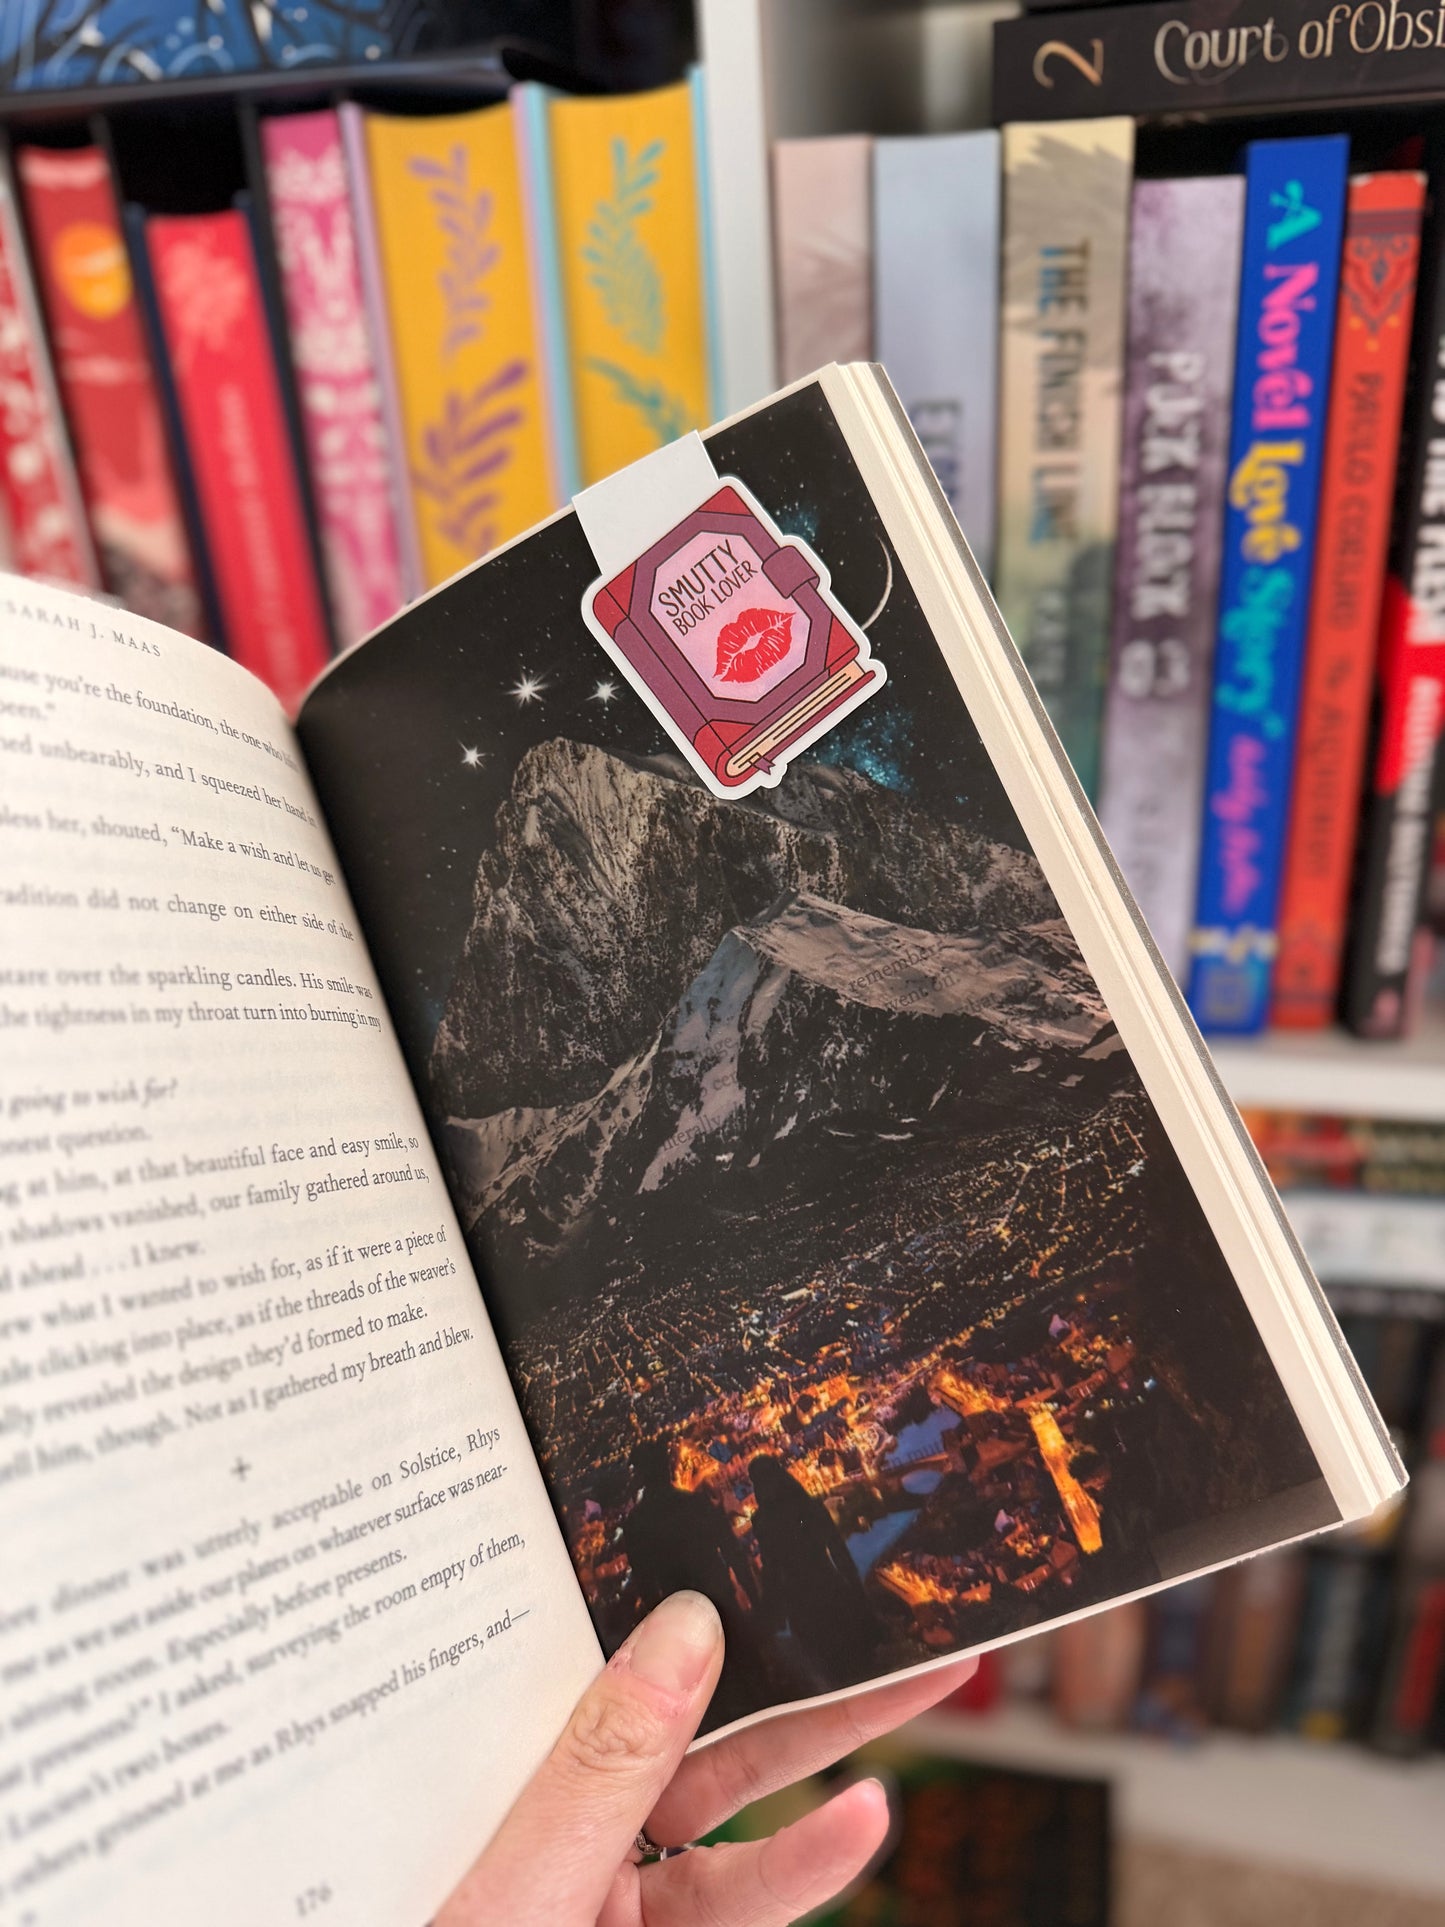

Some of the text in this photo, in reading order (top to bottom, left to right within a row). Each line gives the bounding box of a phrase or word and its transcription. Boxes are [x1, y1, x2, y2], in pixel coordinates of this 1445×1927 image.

[1034, 38, 1103, 88] 2
[1154, 17, 1288, 84] Court
[1300, 4, 1350, 59] of
[1267, 180, 1322, 251] A
[1038, 240, 1090, 317] THE
[1252, 262, 1319, 430] Novel
[1035, 328, 1086, 453] FINISH
[1230, 440, 1304, 565] Love
[658, 538, 738, 618] SMUTTY
[672, 559, 758, 637] BOOK LOVER
[6, 600, 162, 657] SARAH J. MAAS
[44, 675, 262, 750] you're the foundation, the one
[39, 741, 308, 823] unbearably, and I squeezed her hand
[91, 815, 168, 847] shouted,
[171, 826, 224, 851] “Make
[228, 840, 237, 853] a
[239, 843, 271, 861] wish
[273, 851, 295, 868] and
[296, 854, 310, 873] let
[309, 865, 322, 878] us
[322, 869, 337, 886] get
[87, 887, 354, 941] did not change on either side of the
[109, 961, 140, 985] the
[147, 964, 233, 991] sparkling
[236, 968, 297, 988] candles.
[299, 972, 325, 990] His
[327, 976, 355, 994] smile
[355, 986, 373, 999] was
[155, 1006, 184, 1029] my
[187, 1001, 240, 1022] throat
[243, 1006, 276, 1021] turn
[279, 1003, 308, 1020] into
[309, 1004, 359, 1029] burning
[356, 1009, 368, 1026] in
[366, 1016, 382, 1033] my
[138, 1157, 179, 1183] that
[183, 1146, 266, 1175] beautiful
[271, 1142, 305, 1164] face
[310, 1137, 338, 1159] and
[341, 1138, 370, 1158] easy
[374, 1132, 408, 1153] smile,
[408, 1136, 419, 1150] so
[209, 1192, 241, 1212] our
[246, 1179, 301, 1206] family
[305, 1168, 370, 1202] gathered
[371, 1164, 414, 1185] around
[414, 1168, 430, 1183] us,
[223, 1264, 266, 1289] wish
[271, 1257, 302, 1280] for,
[306, 1258, 323, 1272] as
[327, 1245, 339, 1268] if
[342, 1245, 355, 1264] it
[358, 1241, 392, 1260] were
[395, 1239, 404, 1251] a
[405, 1230, 436, 1256] piece
[436, 1224, 448, 1243] of
[236, 1312, 256, 1329] as
[256, 1302, 273, 1324] if
[276, 1295, 304, 1318] the
[306, 1281, 366, 1311] threads
[367, 1273, 383, 1295] of
[385, 1270, 408, 1292] the
[409, 1257, 457, 1284] weaver's
[245, 1337, 303, 1368] they'd
[307, 1316, 365, 1352] formed
[368, 1315, 384, 1334] to
[387, 1303, 428, 1330] make.
[262, 1363, 339, 1410] gathered
[341, 1361, 367, 1383] my
[369, 1344, 417, 1373] breath
[418, 1332, 444, 1356] and
[445, 1325, 474, 1348] blew.
[272, 1426, 501, 1529] acceptable on Solstice, Rhys
[293, 1543, 317, 1562] on
[318, 1511, 392, 1553] whatever
[394, 1482, 448, 1524] surface
[448, 1476, 475, 1499] was
[475, 1463, 509, 1490] near-
[334, 1547, 408, 1598] presents.
[343, 1603, 372, 1630] the
[374, 1582, 418, 1615] room
[420, 1558, 466, 1593] empty
[469, 1543, 485, 1570] of
[486, 1531, 526, 1560] them,
[329, 1669, 399, 1725] snapped
[401, 1659, 427, 1687] his
[428, 1631, 485, 1673] fingers,
[485, 1608, 531, 1640] and—
